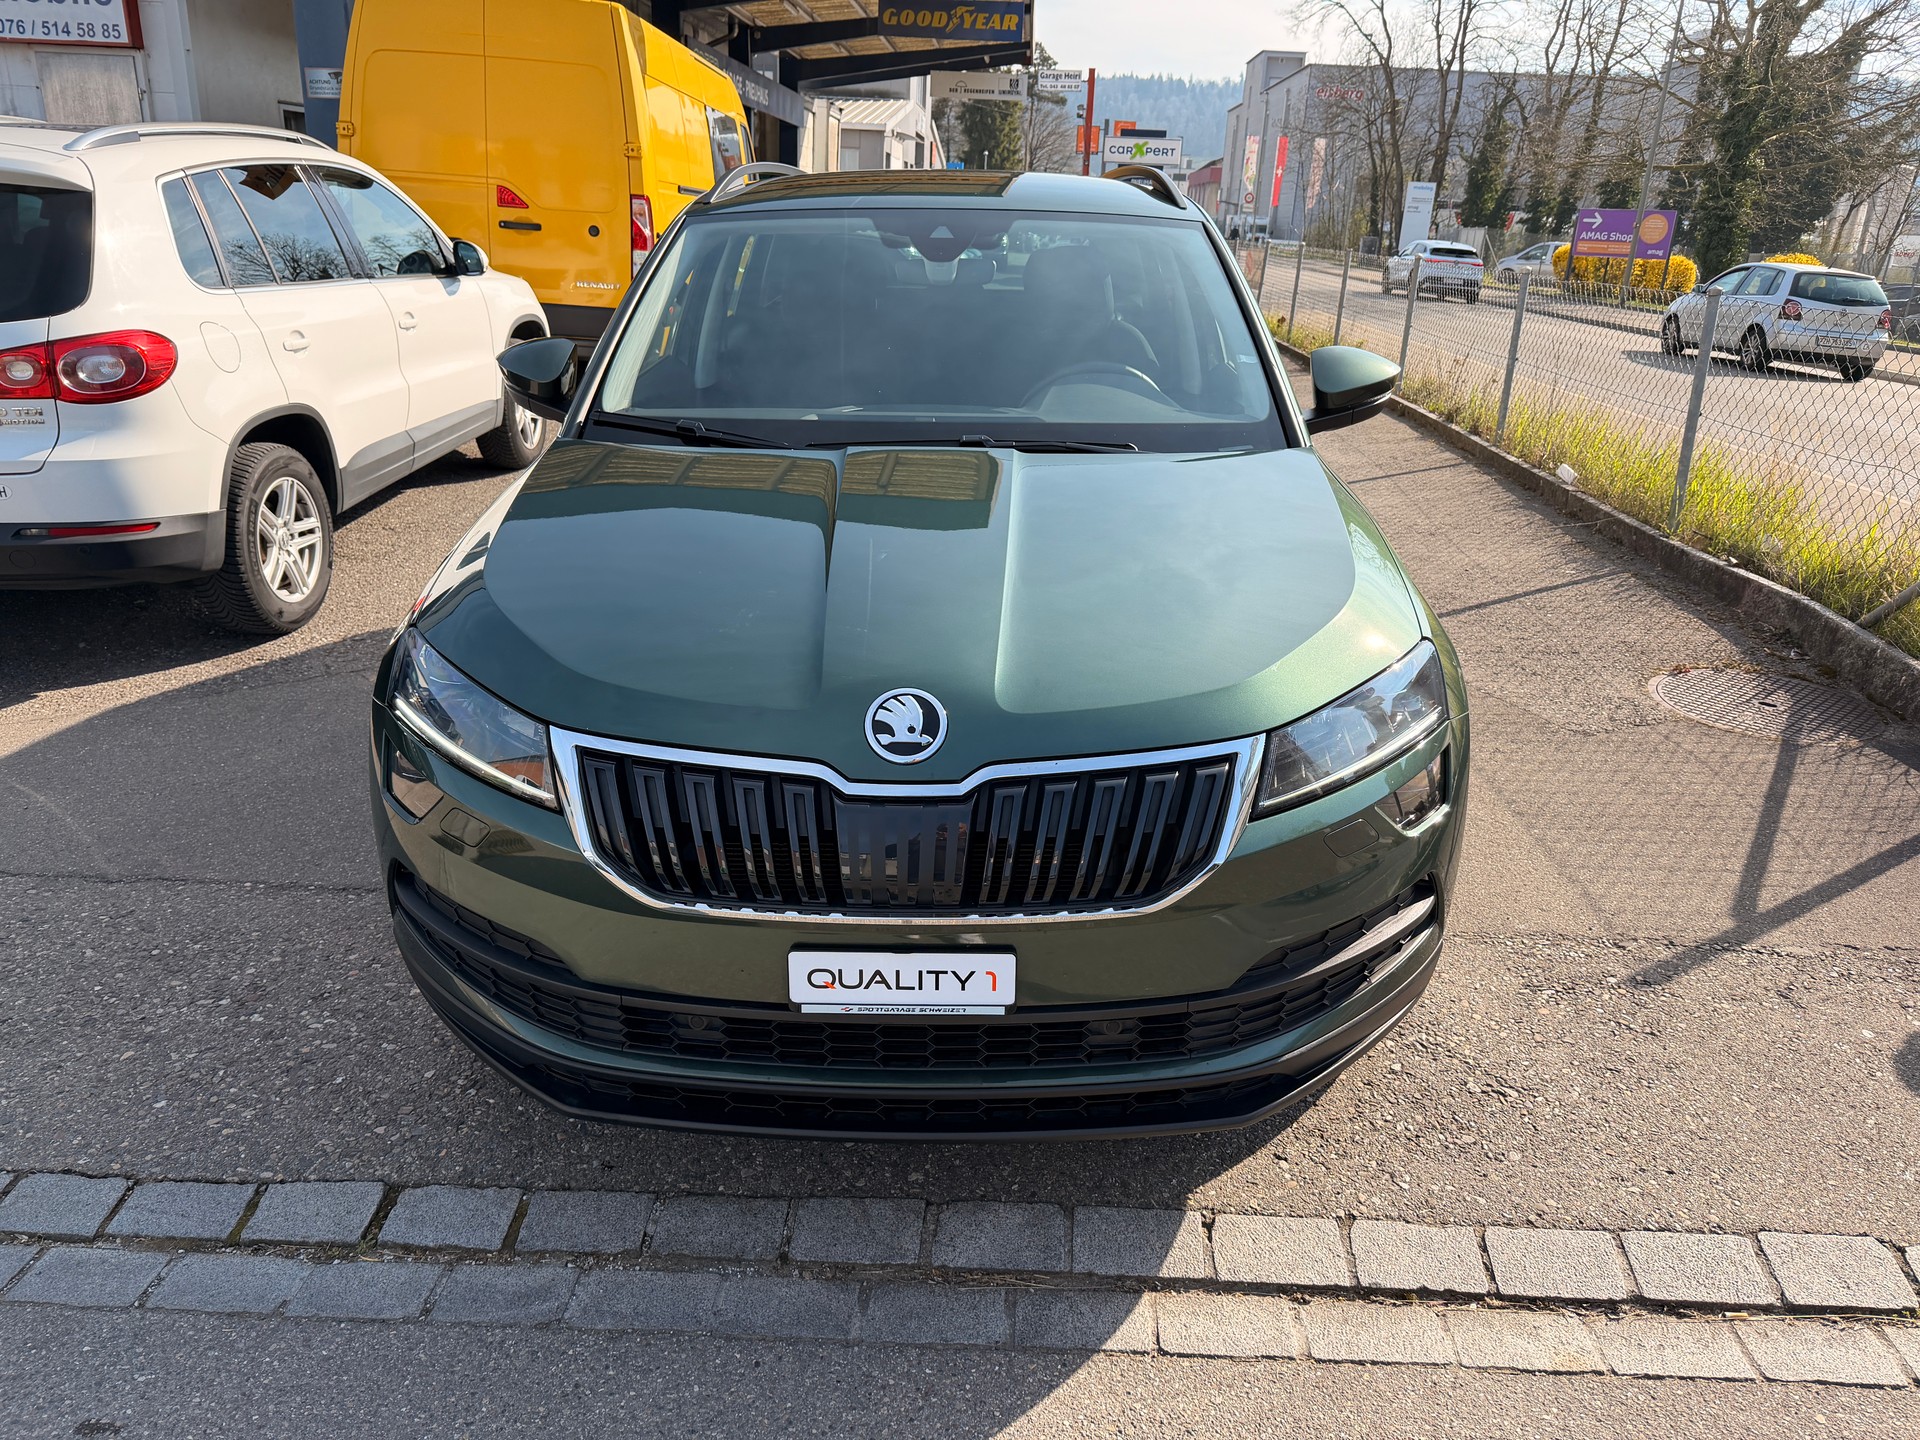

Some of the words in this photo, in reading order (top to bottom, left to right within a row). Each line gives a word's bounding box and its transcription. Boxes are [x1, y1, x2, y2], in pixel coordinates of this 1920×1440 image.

[31, 20, 35, 35] /
[41, 20, 71, 37] 514
[77, 22, 96, 38] 58
[101, 23, 121, 39] 85
[1040, 72, 1063, 81] Garage
[1580, 231, 1608, 240] AMAG
[1610, 232, 1633, 243] Shop
[11, 407, 43, 417] TDI
[807, 968, 976, 991] QUALITY
[985, 970, 997, 992] 1
